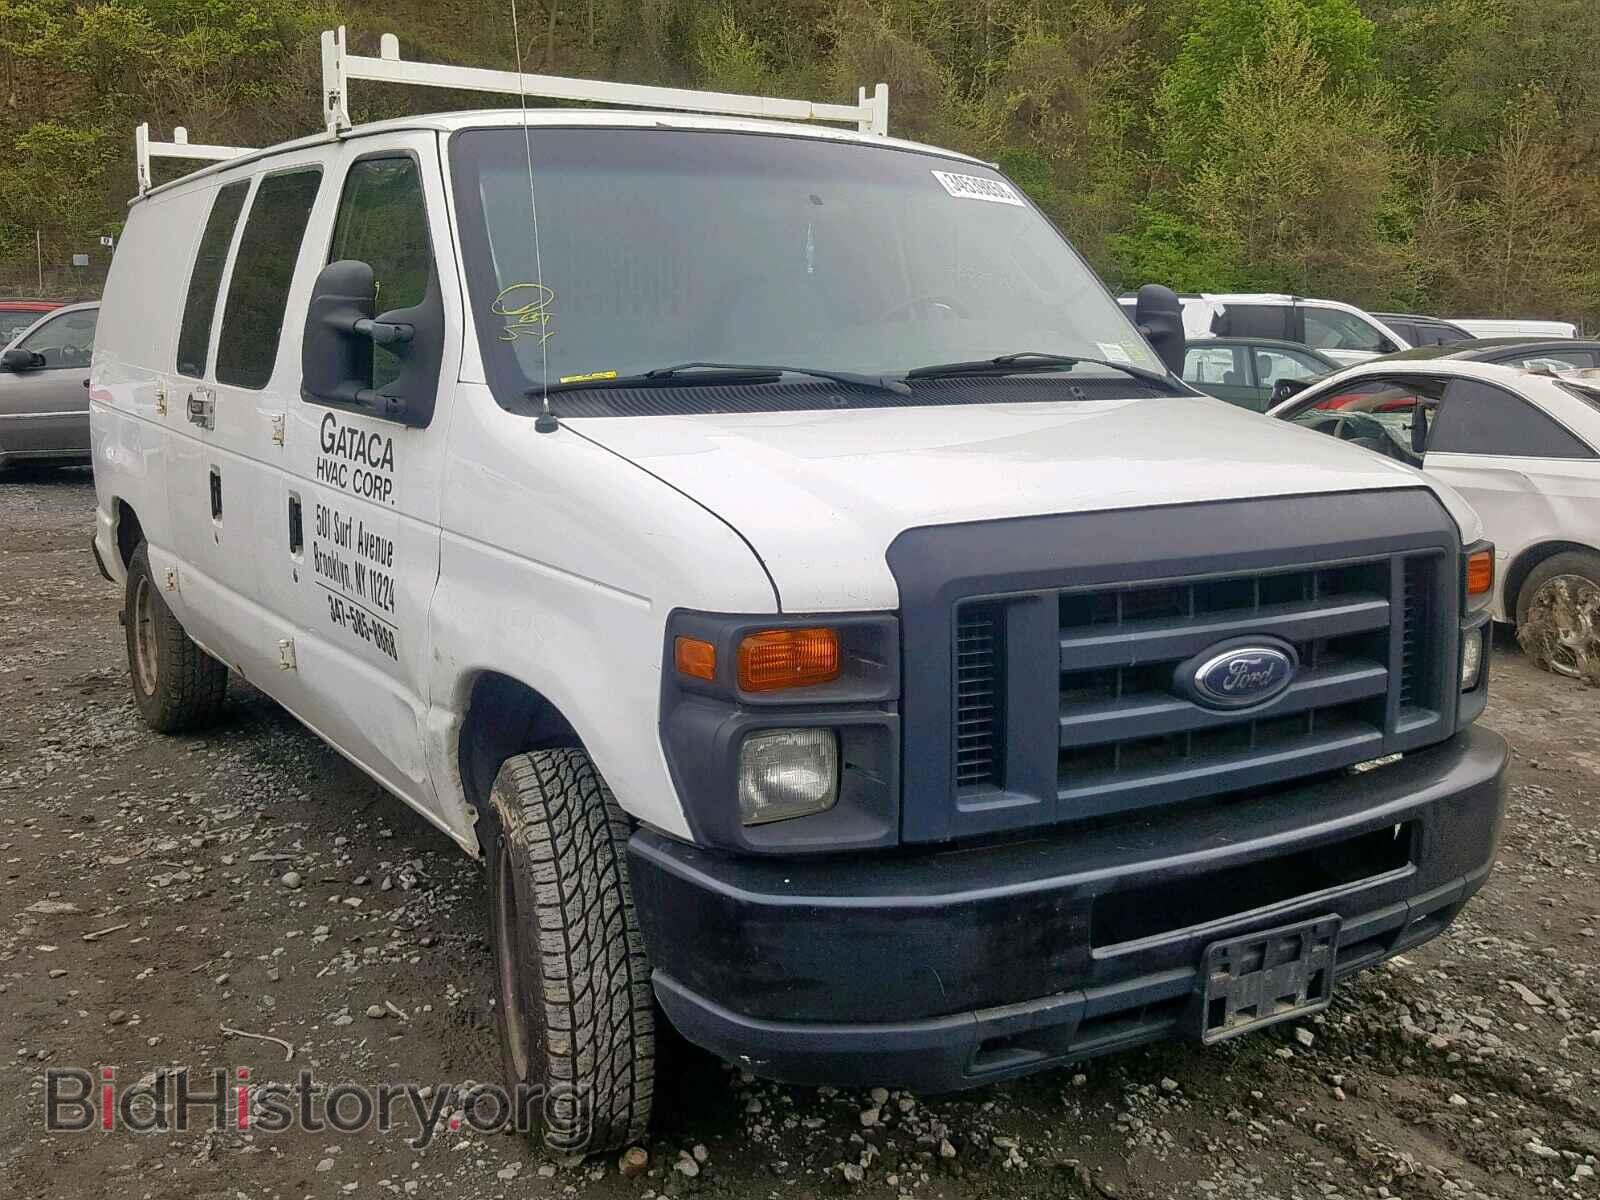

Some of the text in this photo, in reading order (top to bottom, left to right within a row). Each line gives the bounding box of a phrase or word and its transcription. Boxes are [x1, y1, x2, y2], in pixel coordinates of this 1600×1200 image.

[316, 456, 395, 506] HVAC CORP.
[316, 503, 394, 568] 501 Surf Avenue
[355, 560, 367, 599] NY
[369, 568, 395, 615] 11224
[1222, 658, 1275, 690] Ford
